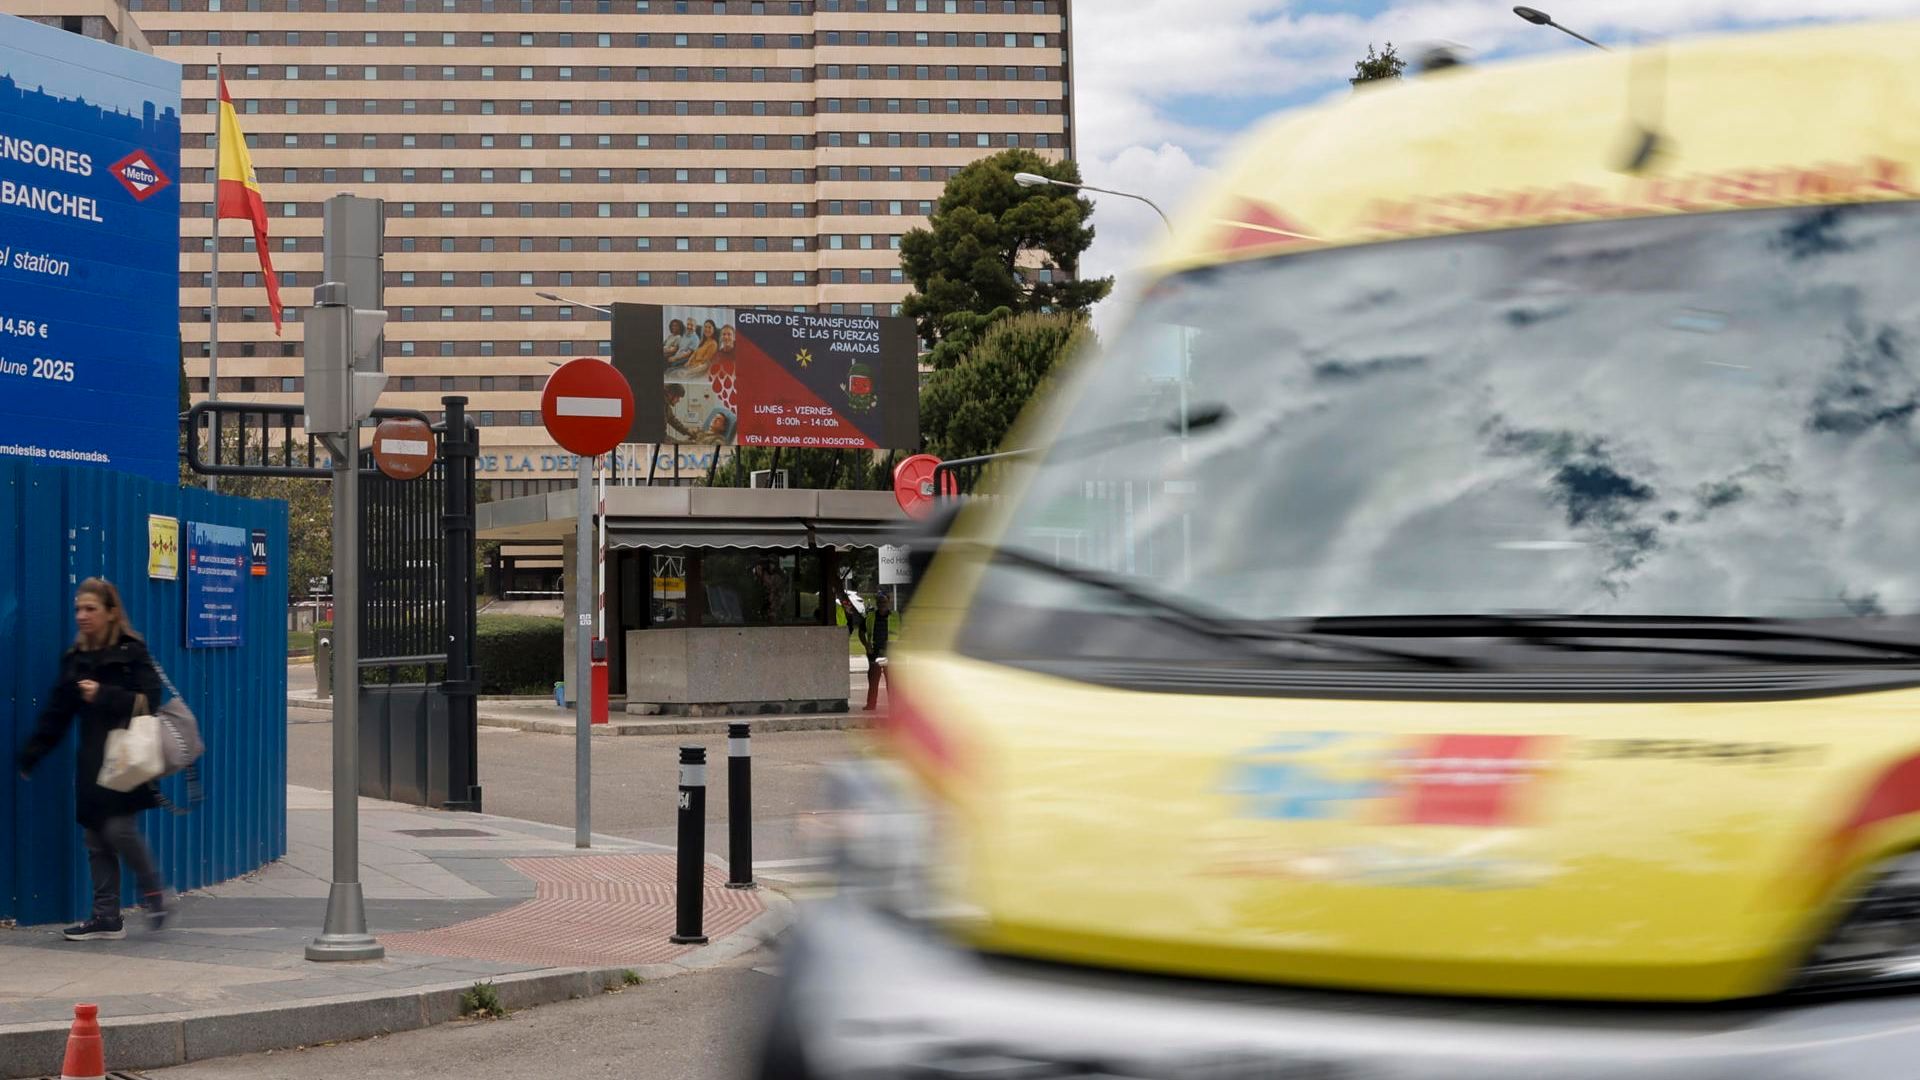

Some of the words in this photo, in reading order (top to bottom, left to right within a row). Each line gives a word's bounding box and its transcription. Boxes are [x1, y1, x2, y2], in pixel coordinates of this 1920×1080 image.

[0, 135, 92, 176] NSORES
[126, 167, 154, 183] Metro
[2, 181, 104, 223] BANCHEL
[13, 251, 69, 276] station
[739, 313, 781, 325] CENTRO
[786, 316, 799, 326] DE
[803, 316, 879, 330] TRANSFUSIÓN
[39, 323, 48, 338] €
[792, 328, 806, 338] DE
[809, 329, 829, 339] LAS
[833, 330, 880, 342] FUERZAS
[830, 343, 880, 354] ARMADAS
[32, 358, 74, 381] 2025
[754, 405, 784, 414] LUNES
[795, 406, 833, 415] VIERNES
[776, 417, 800, 426] 8:00h
[811, 418, 839, 427] 14:00h
[745, 435, 762, 444] VEN
[773, 436, 800, 444] DONAR
[822, 438, 865, 446] NOSOTROS
[0, 444, 47, 458] molestias
[49, 449, 110, 463] ocasionadas.
[504, 455, 535, 472] LA
[251, 542, 267, 557] VIL
